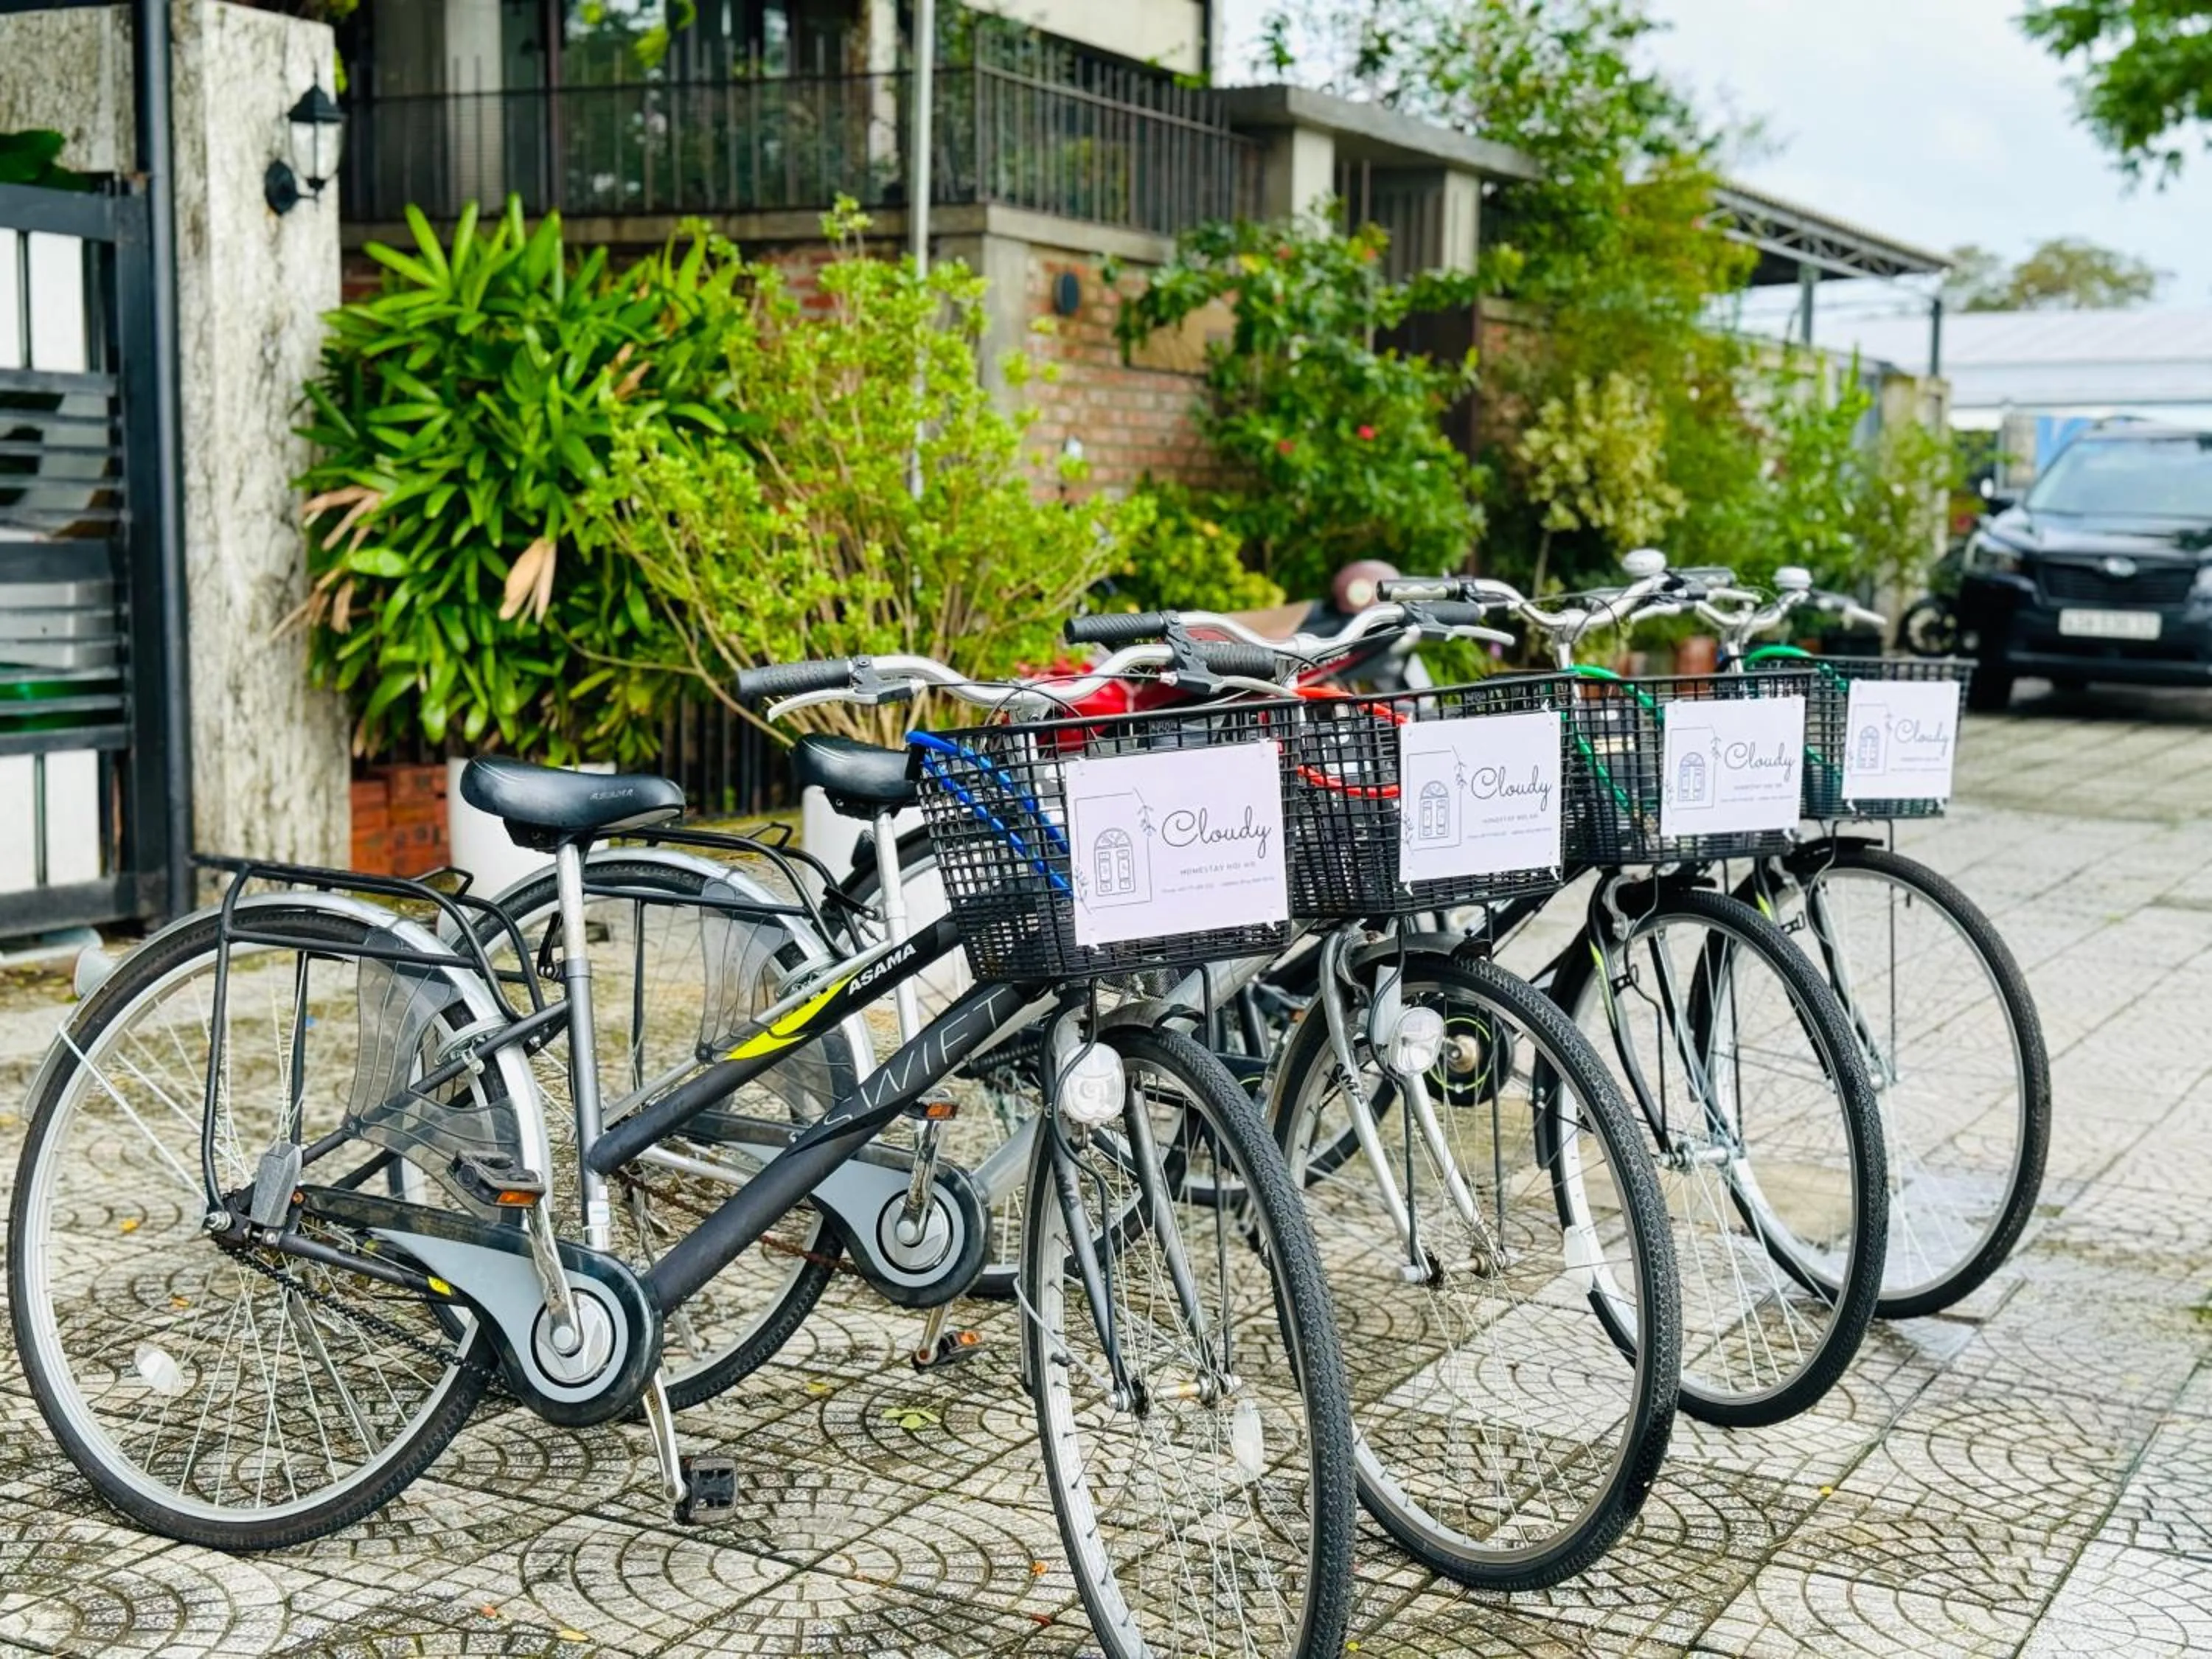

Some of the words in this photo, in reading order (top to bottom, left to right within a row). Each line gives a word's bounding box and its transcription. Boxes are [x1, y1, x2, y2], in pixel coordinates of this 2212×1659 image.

[1724, 742, 1796, 782] Cloudy
[1895, 719, 1950, 757] Cloudy
[1471, 765, 1552, 812] Cloudy
[1161, 805, 1272, 860] Cloudy
[849, 944, 917, 995] ASAMA
[824, 987, 1006, 1126] SWIFT
